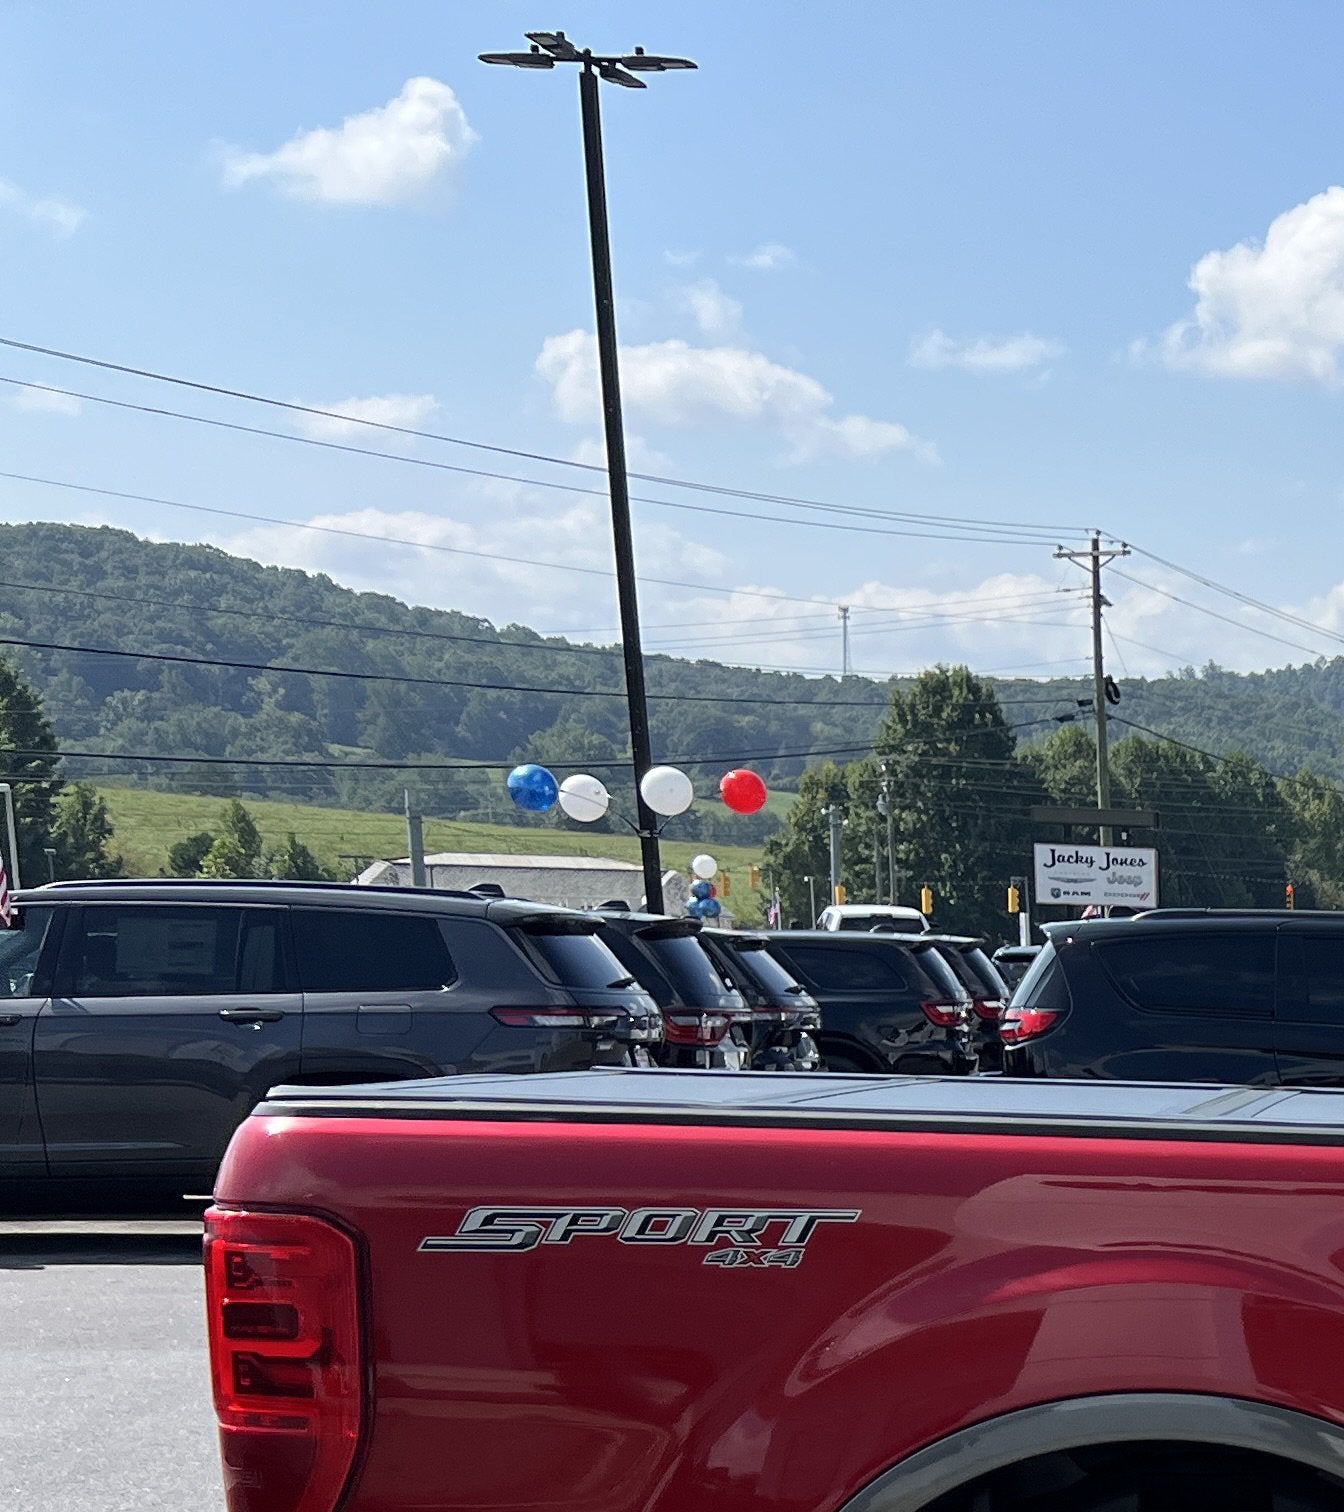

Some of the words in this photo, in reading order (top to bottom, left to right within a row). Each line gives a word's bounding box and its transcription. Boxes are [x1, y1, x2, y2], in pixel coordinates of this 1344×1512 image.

[1043, 848, 1096, 868] Jacky
[1098, 851, 1148, 871] Jones
[1106, 871, 1143, 887] Jeep
[417, 1206, 862, 1252] SPORT
[702, 1248, 805, 1268] 4x4
